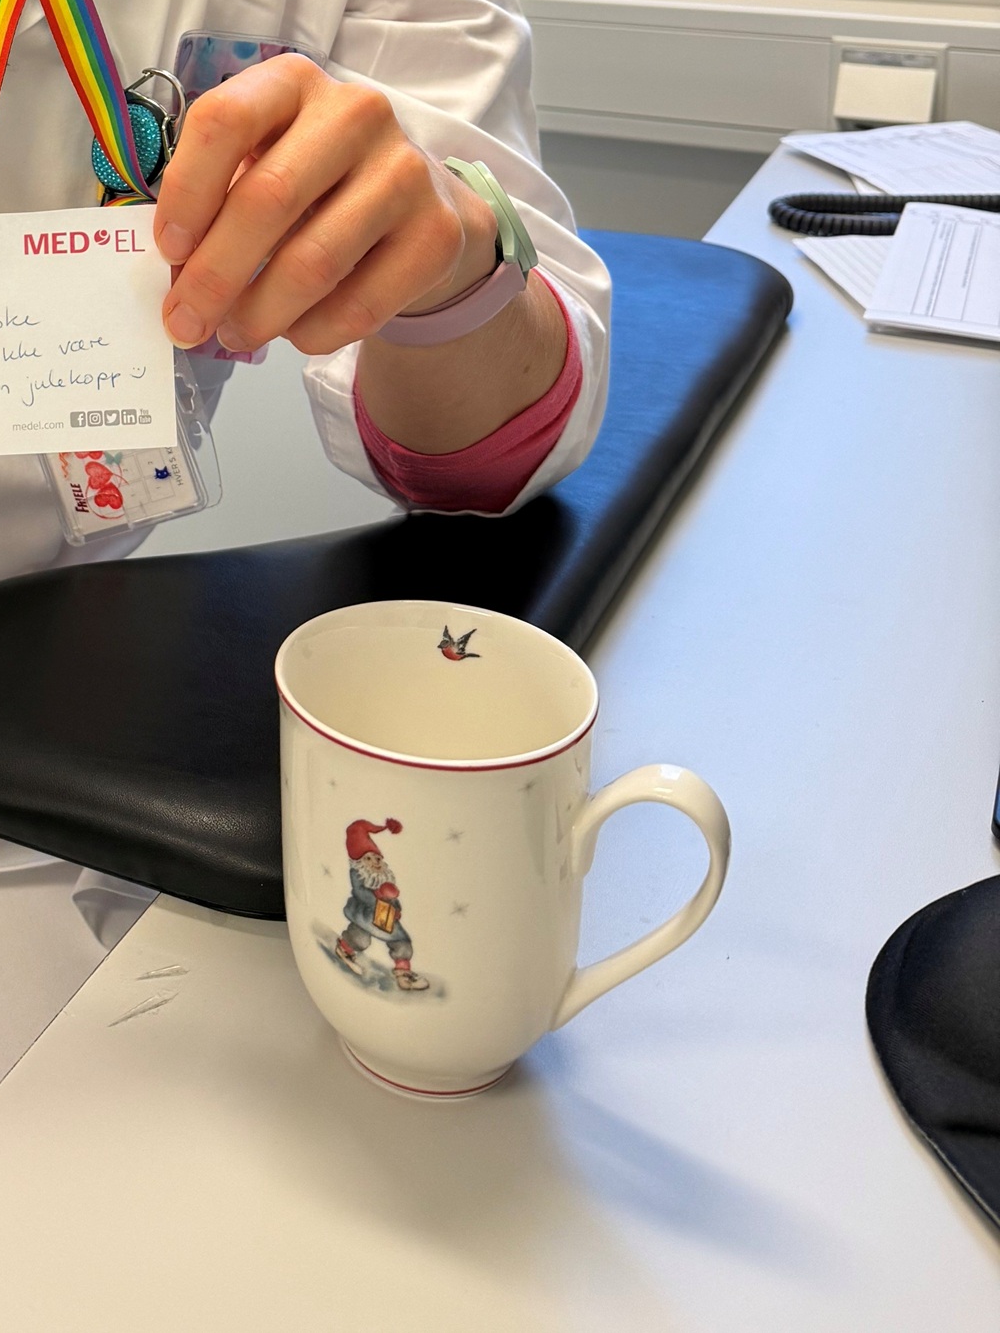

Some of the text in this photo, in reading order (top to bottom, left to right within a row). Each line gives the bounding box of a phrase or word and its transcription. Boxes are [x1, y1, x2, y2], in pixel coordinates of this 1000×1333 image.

[24, 229, 145, 255] MED EL
[59, 336, 110, 355] være
[22, 369, 121, 407] julekopp
[12, 421, 64, 432] medel.com
[70, 483, 89, 513] FRIELE
